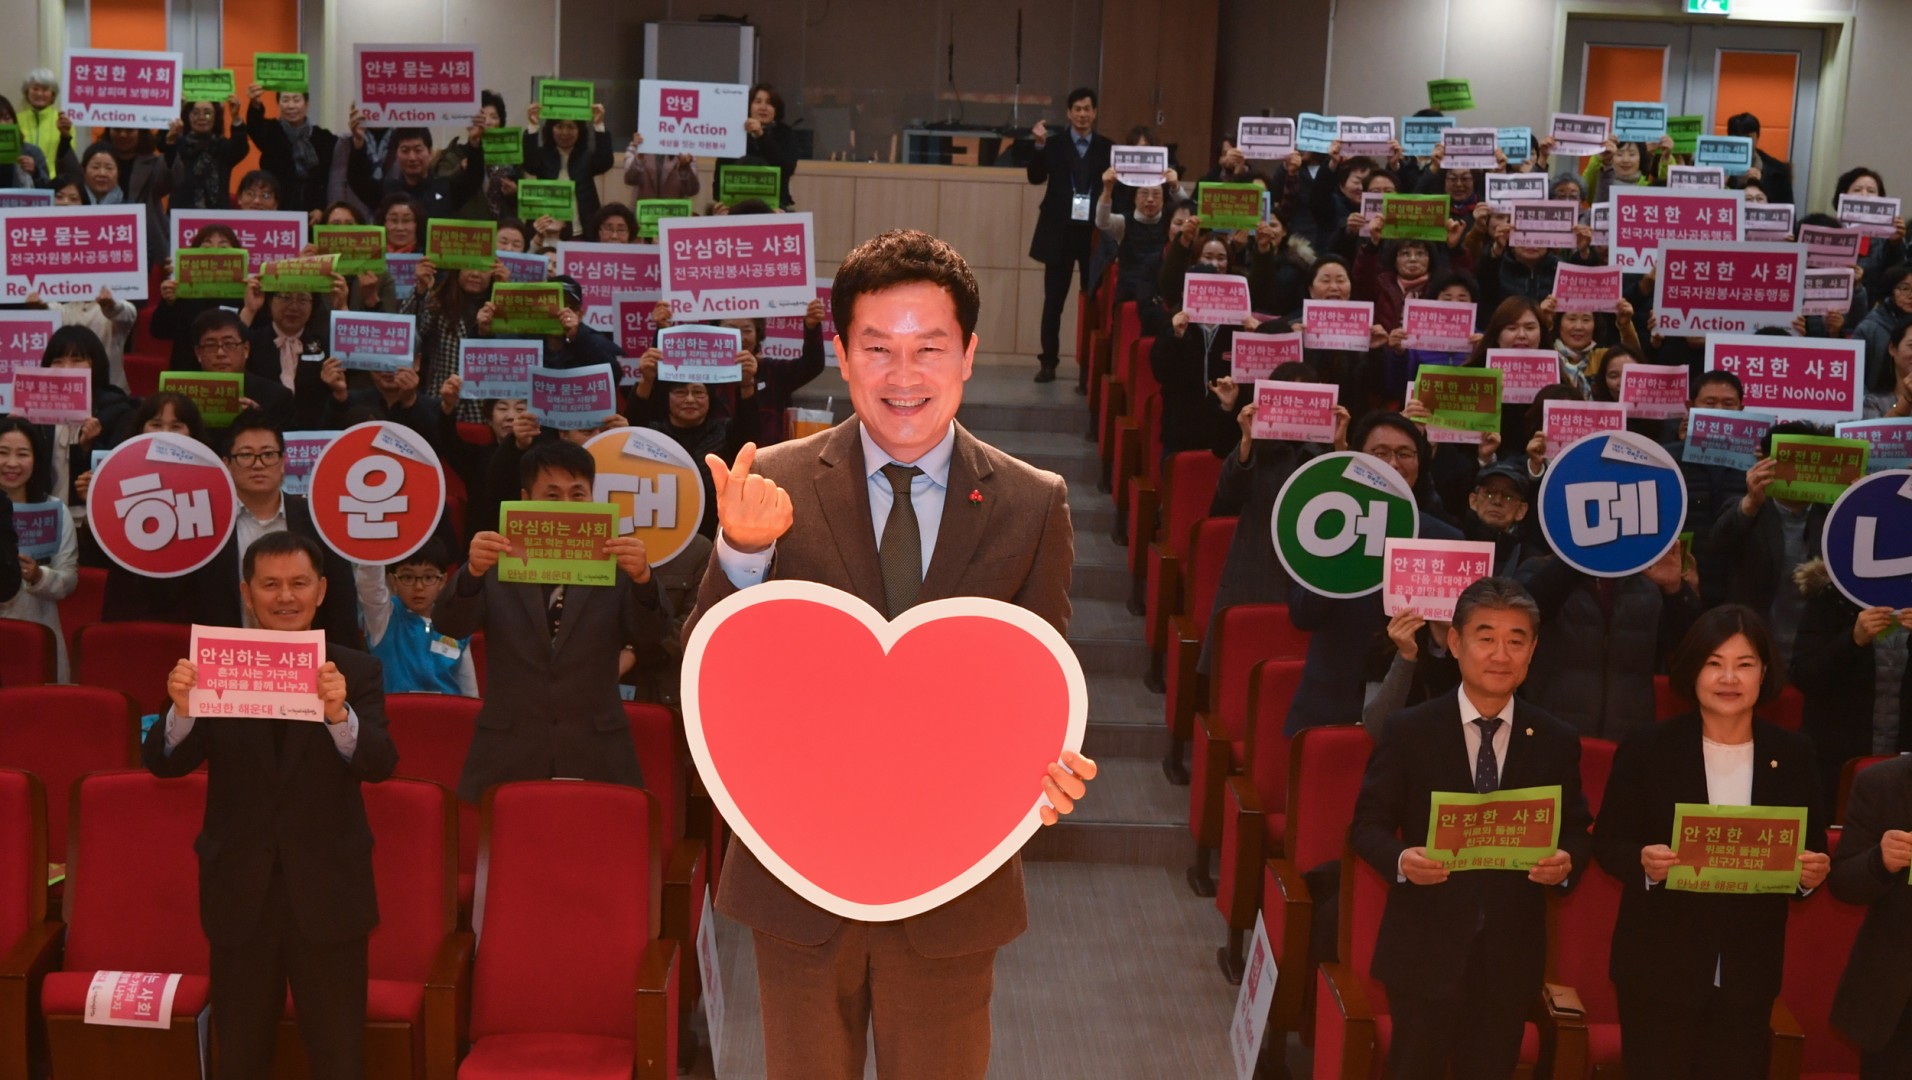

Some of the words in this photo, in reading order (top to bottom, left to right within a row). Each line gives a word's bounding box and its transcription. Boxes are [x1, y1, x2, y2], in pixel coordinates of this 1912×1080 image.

[75, 64, 127, 82] 안전한
[138, 67, 170, 83] 사회
[365, 62, 397, 78] 안부
[403, 62, 434, 78] 묻는
[440, 61, 471, 78] 사회
[74, 85, 94, 97] 주위
[98, 86, 127, 98] 살피며
[130, 87, 170, 100] 보행하기
[365, 83, 471, 95] 전국자원봉사공동행동
[666, 96, 694, 112] 안녕
[1552, 210, 1572, 220] 사회
[1621, 204, 1680, 225] 안전한
[1696, 206, 1734, 226] 사회
[11, 227, 48, 247] 안부
[54, 226, 91, 246] 묻는
[97, 224, 134, 244] 사회
[263, 230, 296, 248] 사회
[674, 238, 754, 261] 안심하는
[762, 235, 801, 258] 사회
[10, 250, 134, 266] 전국자원봉사공동행동
[568, 262, 636, 282] 안심하는
[674, 262, 802, 280] 전국자원봉사공동행동
[1670, 261, 1736, 282] 안전한
[1751, 263, 1793, 283] 사회
[1560, 275, 1598, 287] 안심하는
[1602, 276, 1618, 286] 사회
[1830, 280, 1848, 290] 사회
[1190, 285, 1226, 297] 안심하는
[1230, 286, 1246, 298] 사회
[1667, 285, 1790, 303] 전국자원봉사공동행동
[1308, 311, 1346, 322] 안심하는
[1350, 312, 1368, 323] 사회
[1410, 311, 1448, 324] 안심하는
[1452, 312, 1470, 324] 사회
[337, 324, 380, 338] 안심하는
[386, 328, 407, 338] 사회
[10, 332, 48, 352] 사회
[664, 338, 709, 350] 안심하는
[713, 338, 735, 350] 사회
[1237, 344, 1276, 356] 안심하는
[1280, 344, 1298, 355] 사회
[466, 353, 509, 365] 안심하는
[514, 353, 536, 364] 사회
[1536, 362, 1554, 373] 사회
[1722, 356, 1789, 378] 안전한
[1805, 360, 1848, 382] 사회
[62, 382, 84, 394] 사회
[534, 380, 556, 393] 안부
[561, 384, 583, 395] 묻는
[587, 380, 608, 392] 사회
[1421, 380, 1458, 393] 안전한
[1469, 382, 1494, 394] 사회
[1627, 377, 1667, 388] 안심하는
[1671, 378, 1686, 388] 사회
[216, 385, 236, 397] 사회
[1782, 388, 1846, 402] NoNoNo
[1261, 394, 1304, 408] 안심하는
[1309, 398, 1330, 409] 사회
[1551, 414, 1594, 426] 안심하는
[1599, 415, 1620, 428] 사회
[1696, 420, 1734, 433] 안전한
[1744, 426, 1767, 438] 사회
[1779, 449, 1822, 462] 안전한
[1832, 452, 1860, 467] 사회
[339, 454, 408, 539] 운
[593, 473, 677, 536] 대
[114, 473, 214, 551] 해
[1565, 480, 1658, 547] 메
[510, 520, 571, 537] 안심하는
[578, 522, 608, 538] 사회
[1296, 491, 1388, 557] 어
[1394, 558, 1445, 574] 안전한
[1457, 560, 1486, 576] 사회
[508, 569, 537, 580] 안녕한
[542, 570, 572, 581] 해운대
[1410, 575, 1430, 584] 다음
[1433, 575, 1472, 586] 세대에게
[1417, 586, 1444, 597] 희망을
[1423, 606, 1452, 619] 해운대
[200, 648, 271, 667] 안심하는
[279, 652, 312, 668] 사회
[218, 668, 238, 678] 혼자
[242, 668, 264, 678] 사는
[267, 670, 298, 680] 가구의
[207, 679, 248, 690] 어려움을
[253, 680, 274, 690] 함께
[277, 681, 308, 692] 나누자
[200, 702, 234, 714] 안녕한
[238, 703, 273, 716] 해운대
[1442, 809, 1498, 828] 안전한
[1512, 808, 1550, 824] 사회
[1463, 826, 1492, 837] 위로와
[1684, 826, 1743, 844] 안전한
[1757, 828, 1794, 846] 사회
[1466, 836, 1496, 847] 친구가
[1500, 836, 1520, 846] 되자
[1705, 844, 1736, 855] 위로와
[1472, 857, 1506, 868] 해운대
[1708, 857, 1740, 868] 친구가
[1744, 859, 1764, 870] 되자
[1677, 879, 1710, 890] 안녕한
[1714, 880, 1748, 892] 해운대
